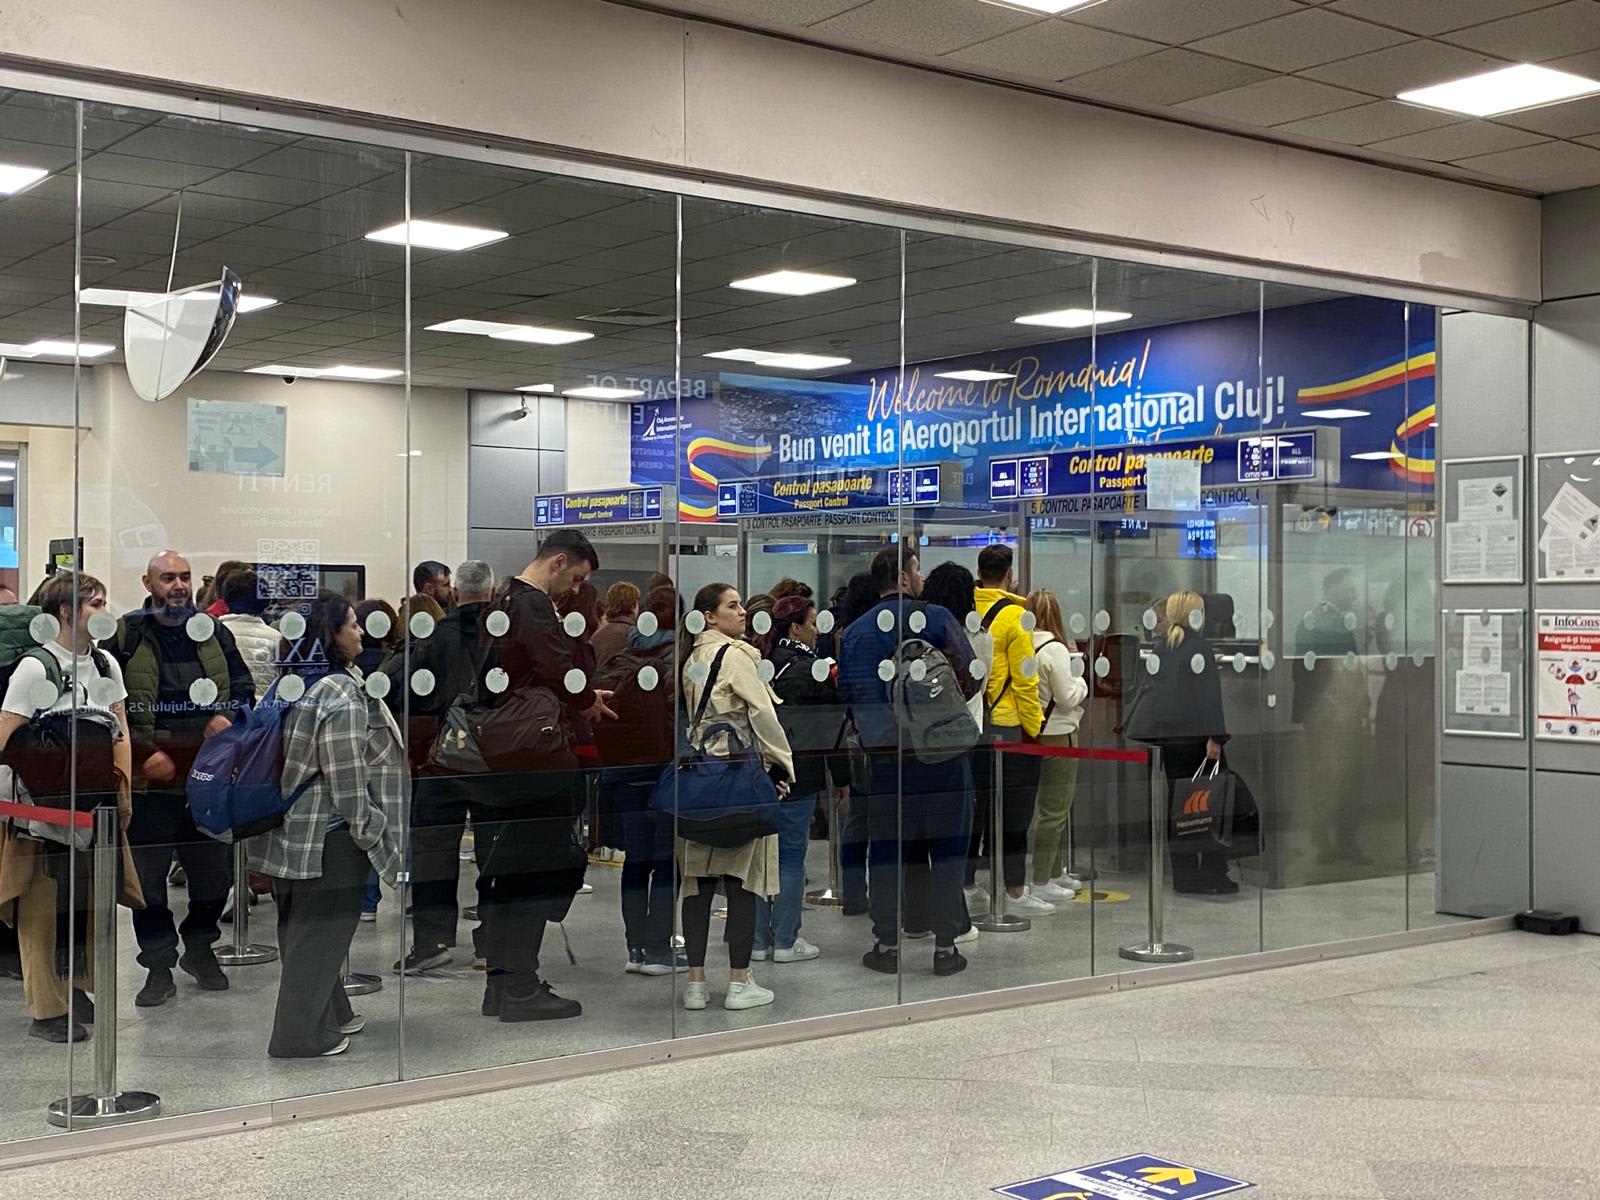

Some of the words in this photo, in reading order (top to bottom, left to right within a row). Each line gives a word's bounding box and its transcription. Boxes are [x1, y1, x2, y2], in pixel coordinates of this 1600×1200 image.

[867, 367, 979, 421] Welcome
[982, 363, 1010, 408] to
[1007, 339, 1151, 410] Romania!
[779, 434, 815, 463] Bun
[821, 425, 871, 459] venit
[876, 422, 895, 454] la
[903, 406, 1021, 454] Aeroportul
[1215, 376, 1285, 423] Cluj!
[1069, 452, 1123, 475] Control
[774, 479, 811, 497] Control
[812, 475, 873, 497] pasapoarte
[1100, 474, 1141, 489] Passport
[566, 497, 589, 509] Control
[794, 499, 823, 510] Passport
[824, 496, 849, 507] Control
[1031, 502, 1037, 514] 5
[1040, 499, 1079, 514] CONTROL
[1081, 495, 1140, 512] PASAPOARTE
[1201, 488, 1250, 504] CONTROL
[752, 518, 780, 529] CONTROL
[782, 515, 822, 528] PASAPOARTE
[824, 512, 861, 525] PASSPORT
[862, 511, 896, 522] CONTROL
[1554, 615, 1600, 627] InfoCons
